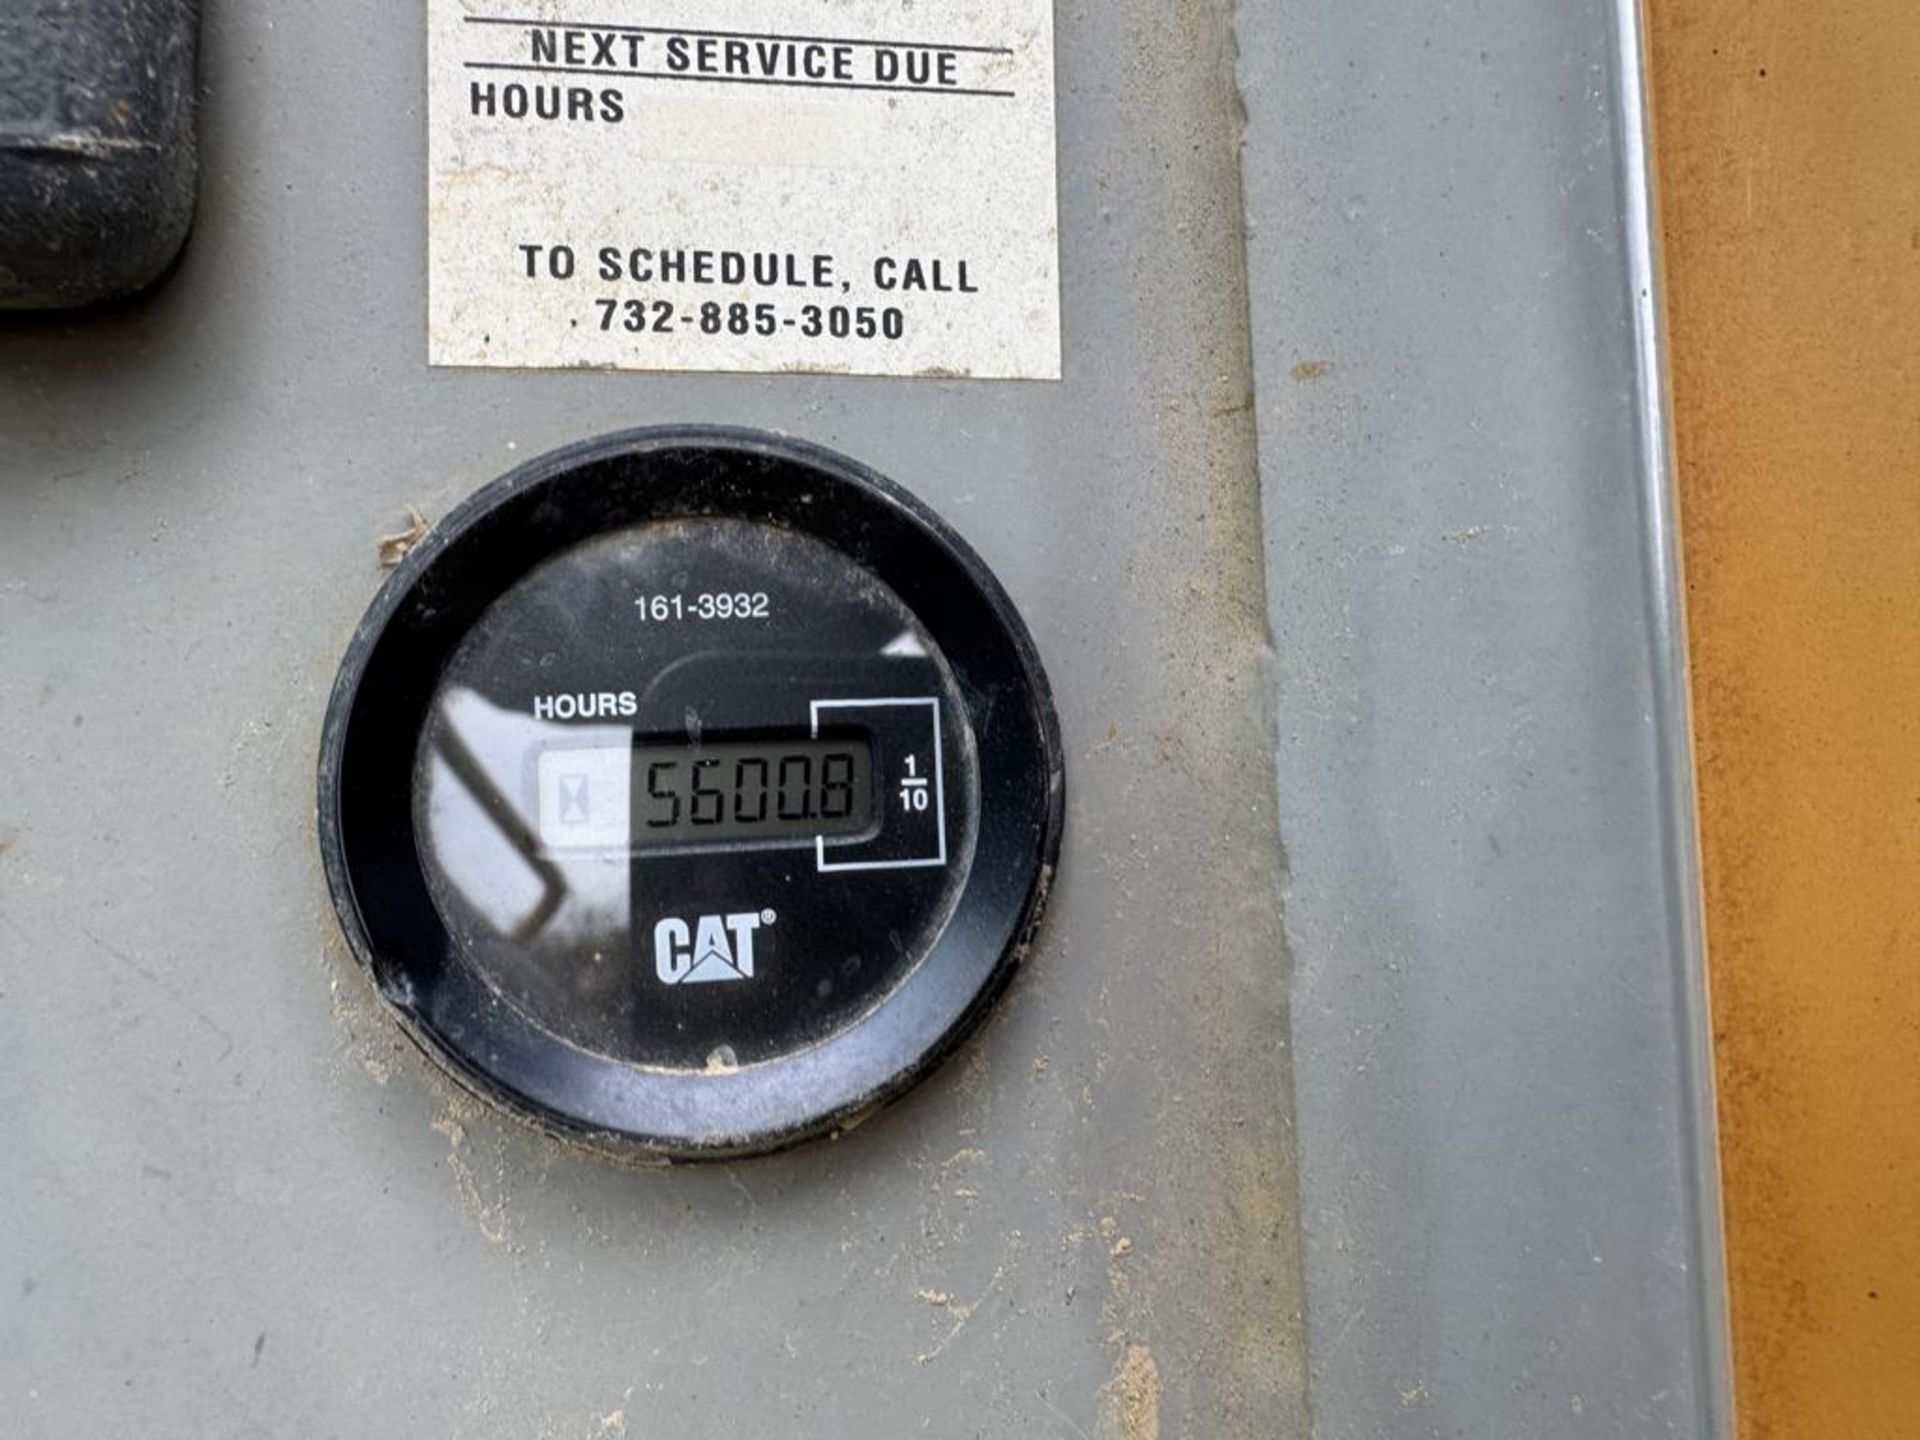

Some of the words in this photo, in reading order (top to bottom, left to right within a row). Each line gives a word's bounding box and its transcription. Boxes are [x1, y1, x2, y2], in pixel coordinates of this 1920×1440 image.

[530, 29, 645, 68] NEXT
[666, 36, 854, 80] SERVICE
[874, 49, 958, 85] DUE
[470, 82, 625, 124] HOURS
[519, 244, 575, 280] TO
[599, 247, 851, 293] SCHEDULE,
[873, 256, 979, 293] CALL
[595, 299, 904, 340] 732-885-3050
[634, 592, 770, 621] 161-3932
[533, 691, 638, 719] HOURS
